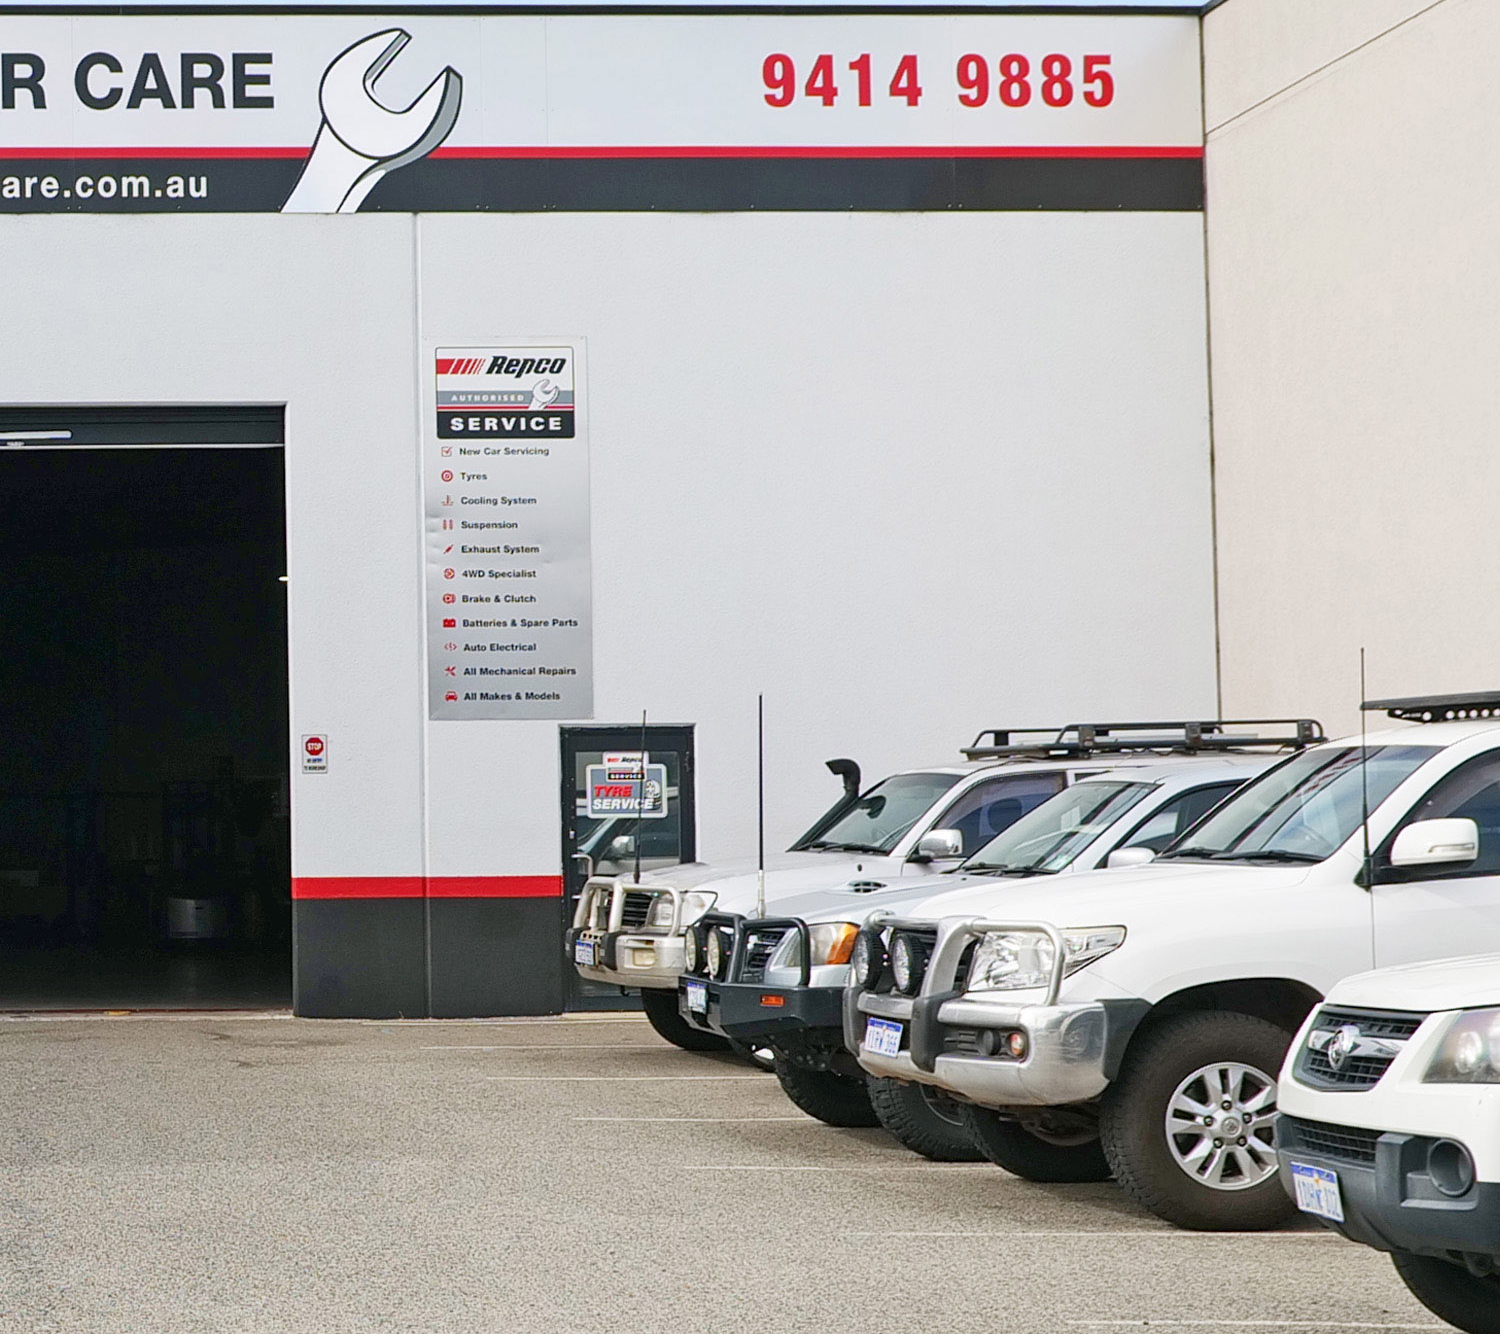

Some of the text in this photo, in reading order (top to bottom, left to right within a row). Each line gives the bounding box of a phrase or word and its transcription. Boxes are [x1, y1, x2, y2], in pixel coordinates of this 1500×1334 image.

[73, 51, 275, 110] CARE
[762, 53, 1115, 108] 9414 9885
[486, 355, 567, 378] Repco
[451, 393, 525, 402] AUTHORISED
[450, 416, 563, 432] SERVICE
[459, 446, 550, 458] New Car Servicing
[459, 472, 488, 482] Tyres
[460, 496, 538, 507] Cooling System
[460, 520, 519, 531] Suspension
[460, 544, 540, 556] Exhaust System
[462, 568, 537, 580] 4WD Specialist
[461, 594, 492, 603] Brake
[503, 594, 537, 604] Clutch
[462, 618, 508, 627] Batteries
[520, 618, 550, 630] Spare
[552, 618, 579, 628] Parts
[463, 642, 537, 652] Auto Electrical
[463, 666, 577, 678] All Mechanical Repairs
[463, 691, 478, 701] All
[480, 691, 512, 701] Makes
[524, 691, 561, 701] Models
[594, 786, 634, 797] TYRE
[592, 798, 654, 810] SERVICE
